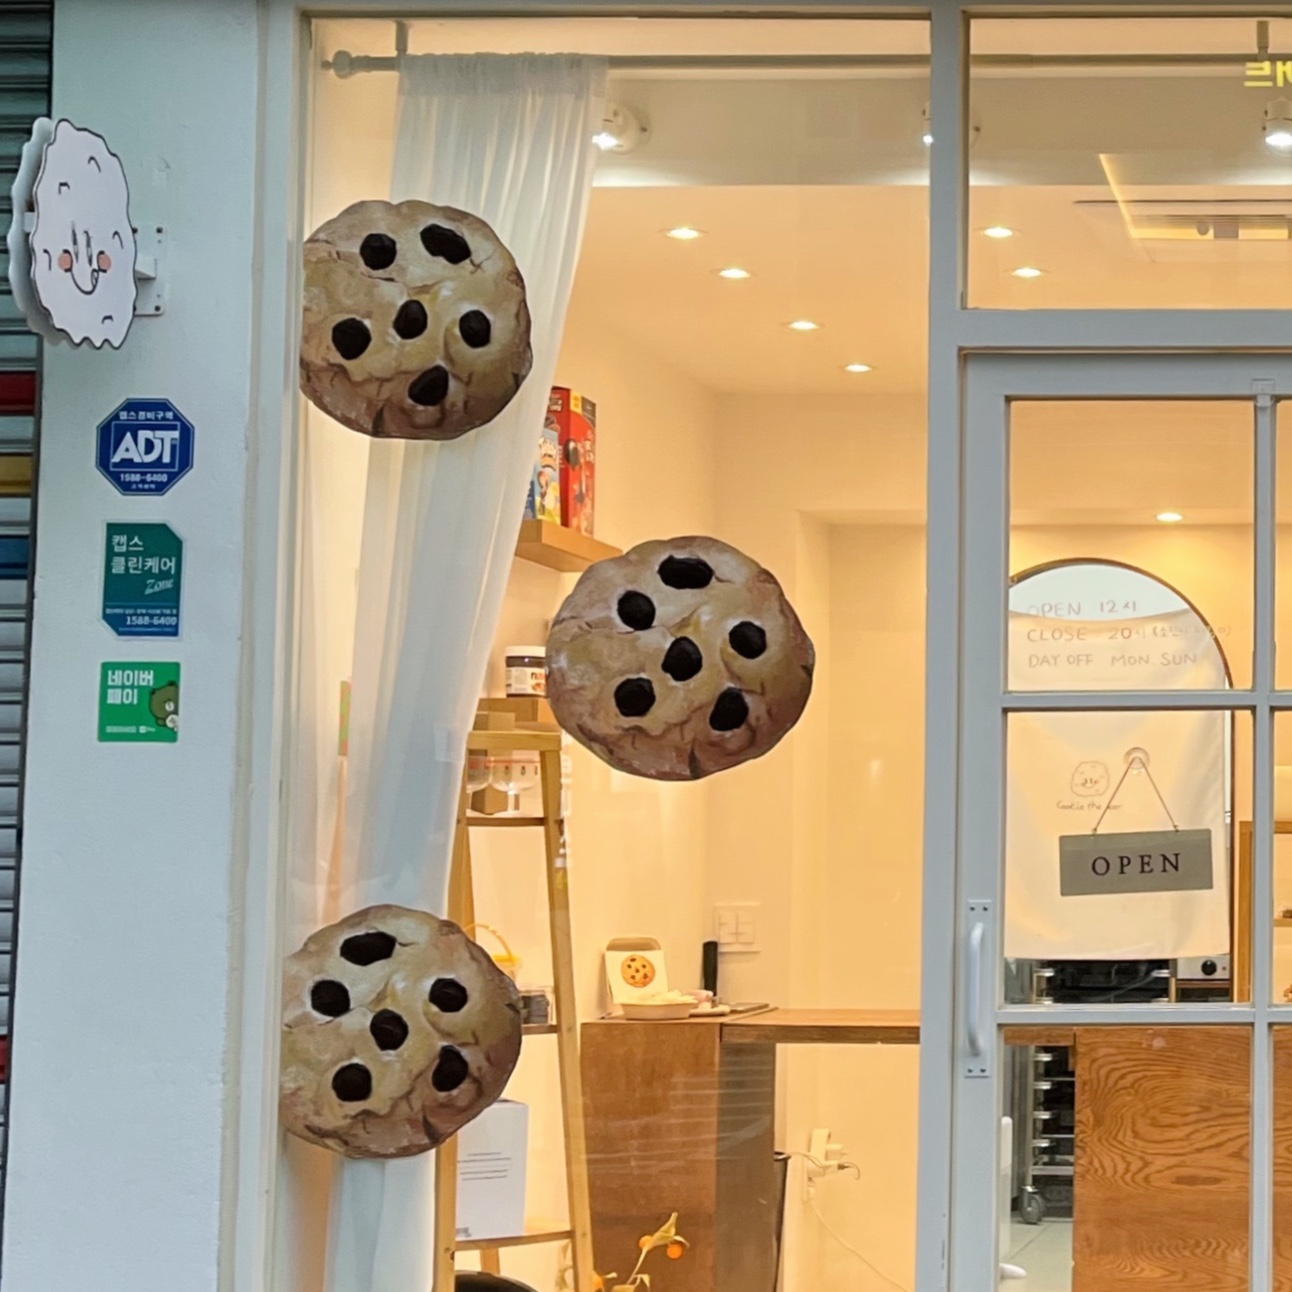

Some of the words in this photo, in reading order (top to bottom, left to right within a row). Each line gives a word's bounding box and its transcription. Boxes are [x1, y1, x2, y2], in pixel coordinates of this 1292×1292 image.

[111, 430, 179, 464] ADT
[111, 534, 144, 552] 캡스
[111, 556, 176, 575] 클린케어
[144, 578, 174, 595] Zone
[125, 616, 178, 626] 1588-6400
[1027, 627, 1087, 643] CLOSE
[1028, 653, 1060, 668] DAY
[1066, 653, 1094, 666] OFF
[1160, 653, 1197, 667] SUN
[107, 669, 154, 687] 네이버
[106, 688, 138, 705] 페이
[1091, 853, 1181, 876] OPEN
